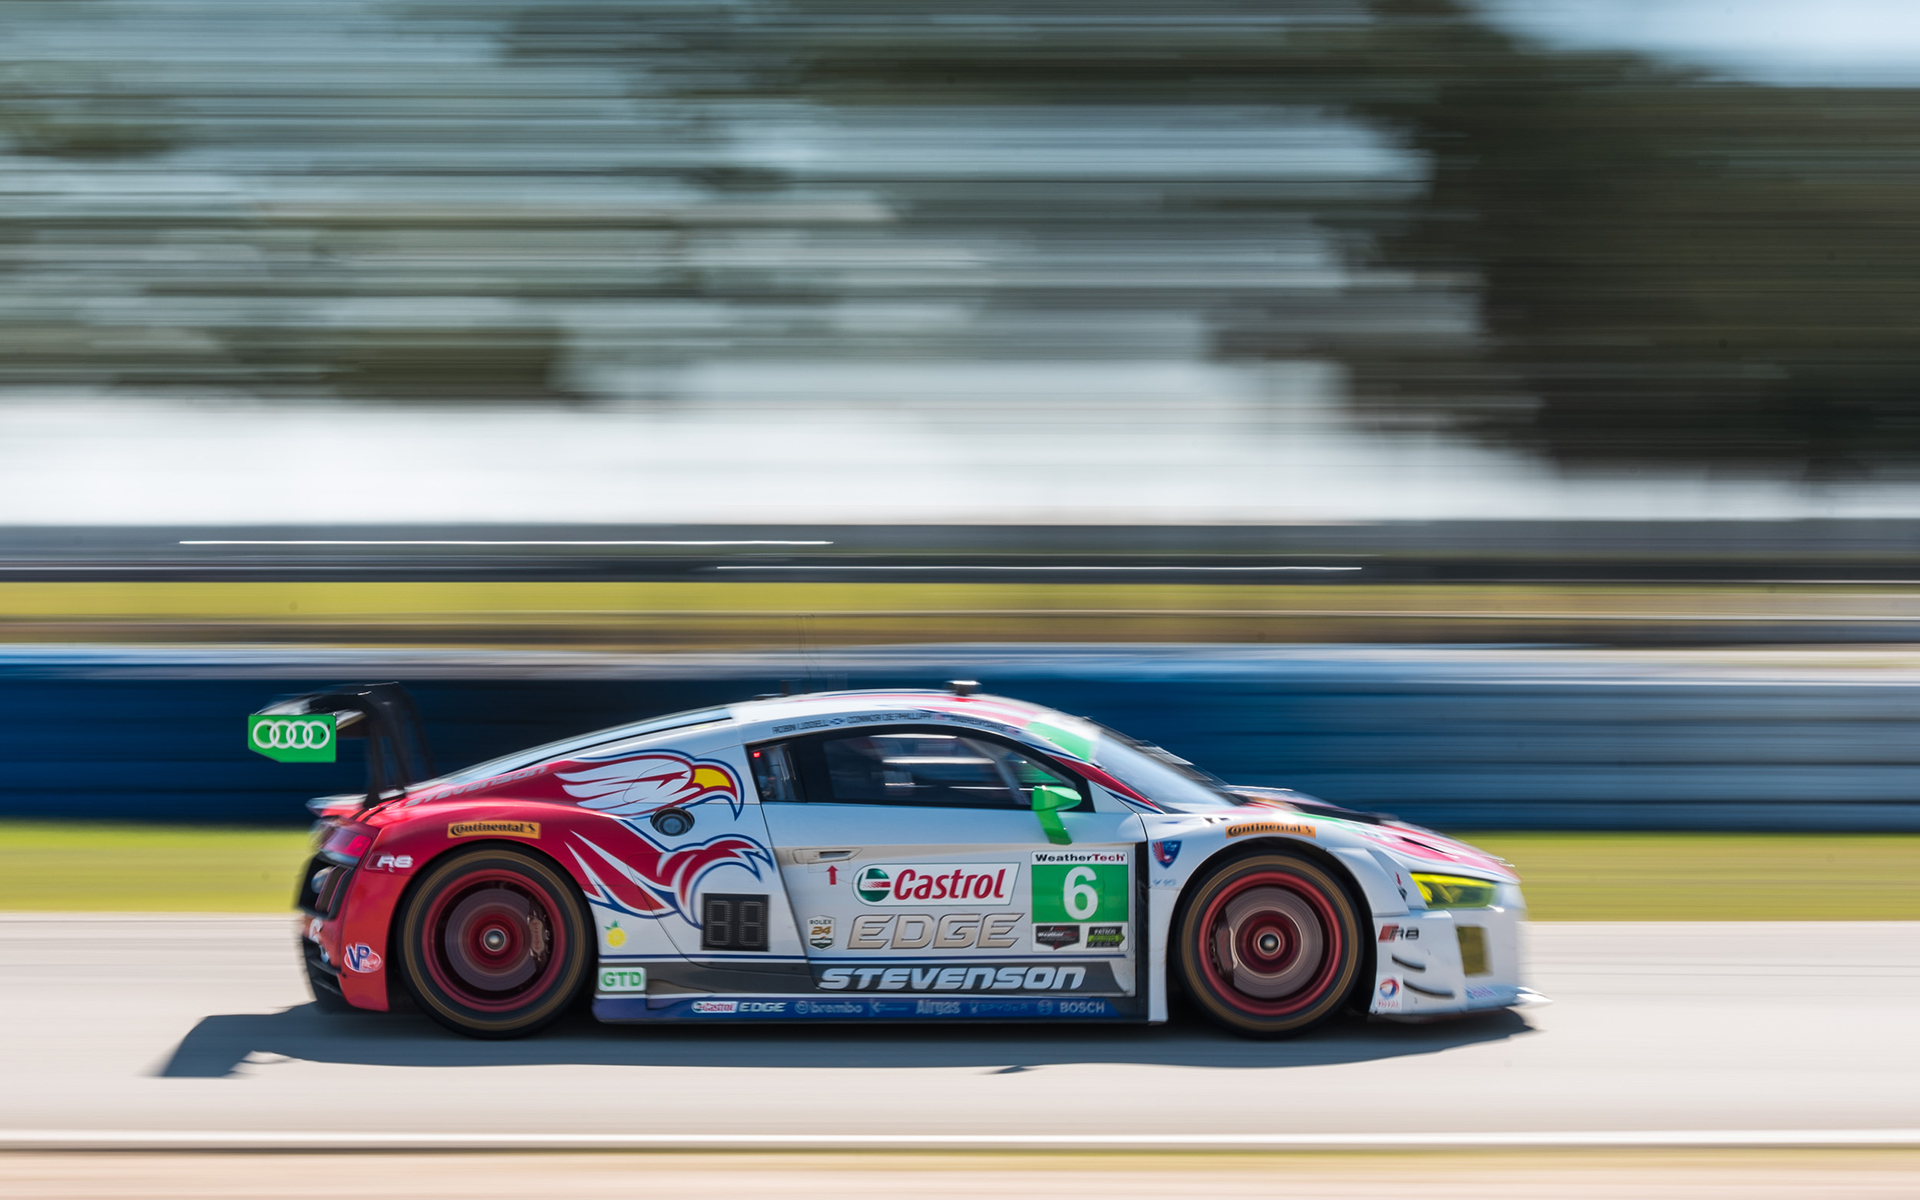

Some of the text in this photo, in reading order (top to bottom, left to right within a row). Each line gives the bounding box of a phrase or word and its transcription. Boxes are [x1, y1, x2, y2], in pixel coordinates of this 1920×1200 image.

[404, 766, 547, 808] STEVENSON
[450, 823, 525, 836] Continental
[1227, 822, 1301, 837] Continental
[376, 854, 413, 869] R8
[1035, 854, 1124, 862] WeatherTech
[893, 868, 1006, 901] Castrol
[1063, 865, 1099, 920] 6
[811, 926, 832, 936] 24
[846, 912, 1025, 950] EDGE
[1389, 925, 1420, 941] R8
[345, 943, 372, 971] VP
[601, 971, 642, 988] GTD
[817, 966, 1087, 990] STEVENSON
[739, 1002, 788, 1012] EDGE
[811, 1002, 863, 1013] brembo
[916, 1000, 961, 1015] Airgas
[1059, 1001, 1106, 1014] BOSCH
